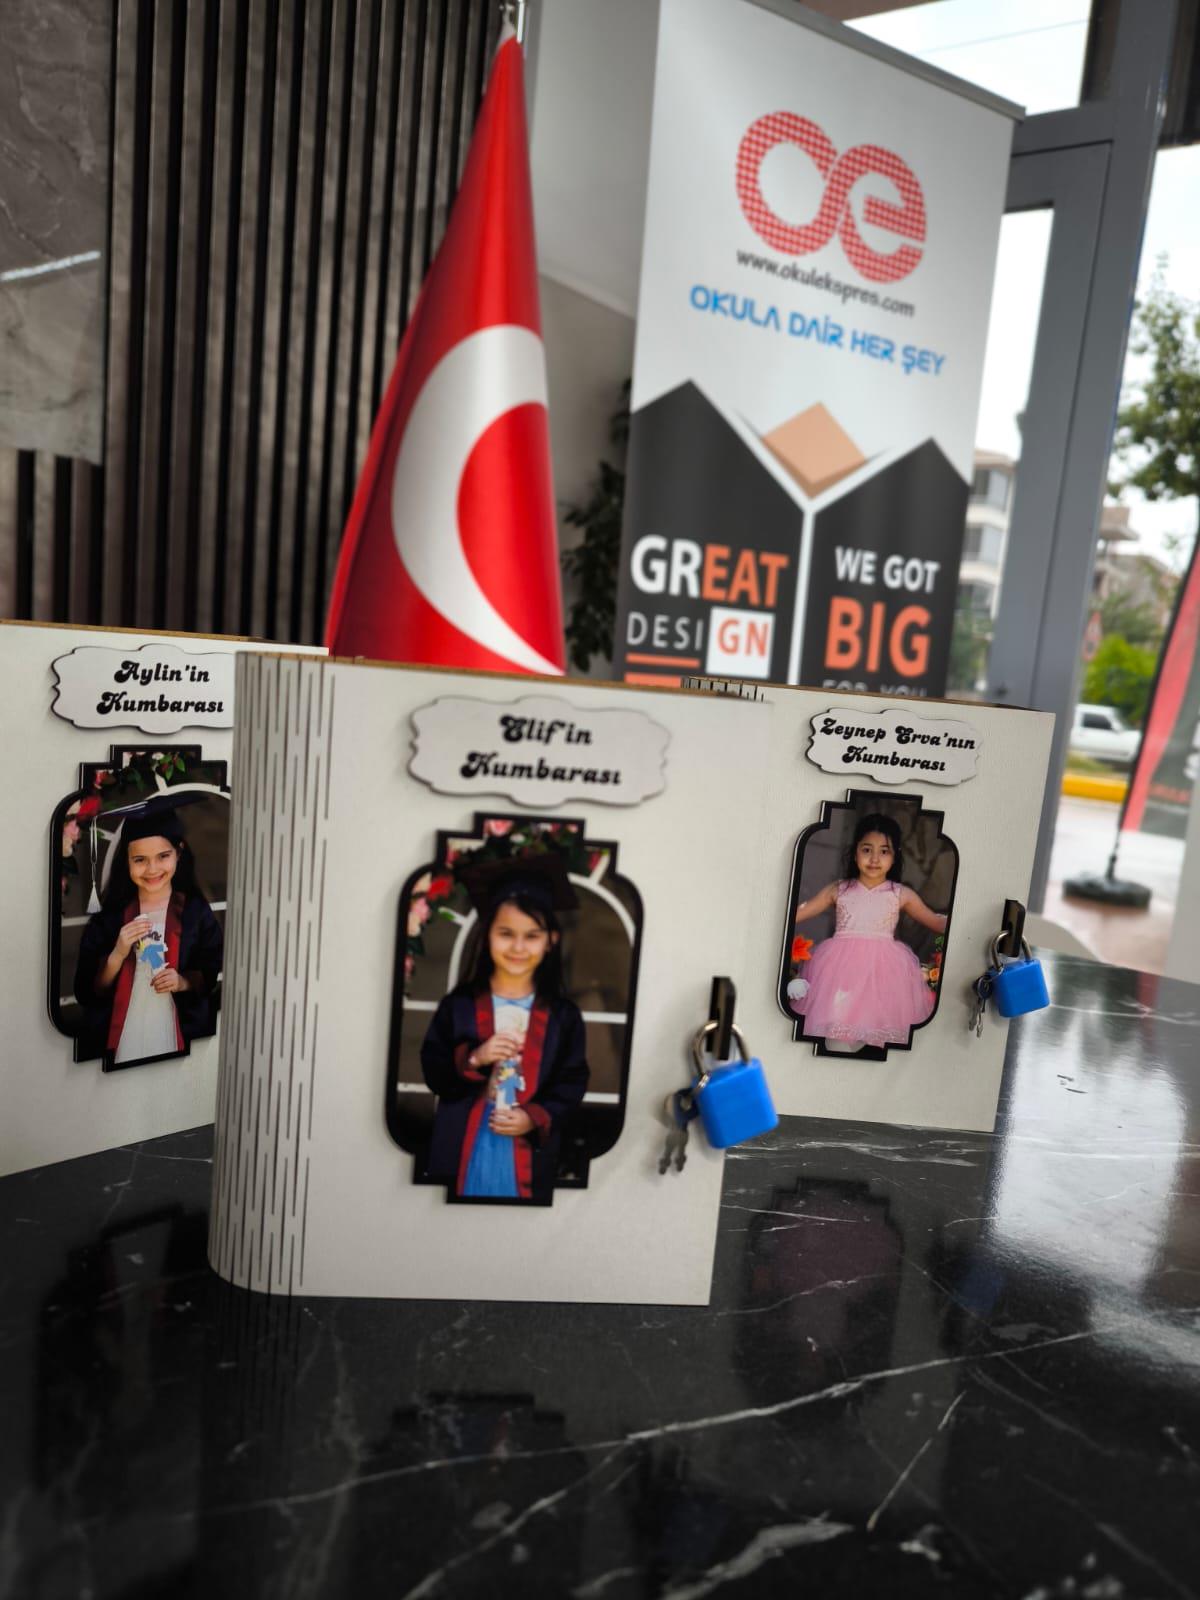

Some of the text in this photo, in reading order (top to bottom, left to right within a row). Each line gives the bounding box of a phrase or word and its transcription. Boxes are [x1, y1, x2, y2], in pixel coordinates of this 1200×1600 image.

[736, 249, 915, 317] www.okulekspres.com
[690, 285, 946, 374] OKULA DAİR HER ŞEY
[630, 534, 789, 607] GREAT
[835, 546, 940, 594] WE GOT
[824, 596, 932, 678] BIG
[114, 660, 210, 686] Aylin'in
[96, 691, 224, 715] Kumbarası
[499, 714, 592, 746] Elif'in
[820, 717, 975, 750] Zeynep Erva'nın
[460, 752, 621, 786] Kumbarası
[842, 745, 946, 772] Kumbarası
